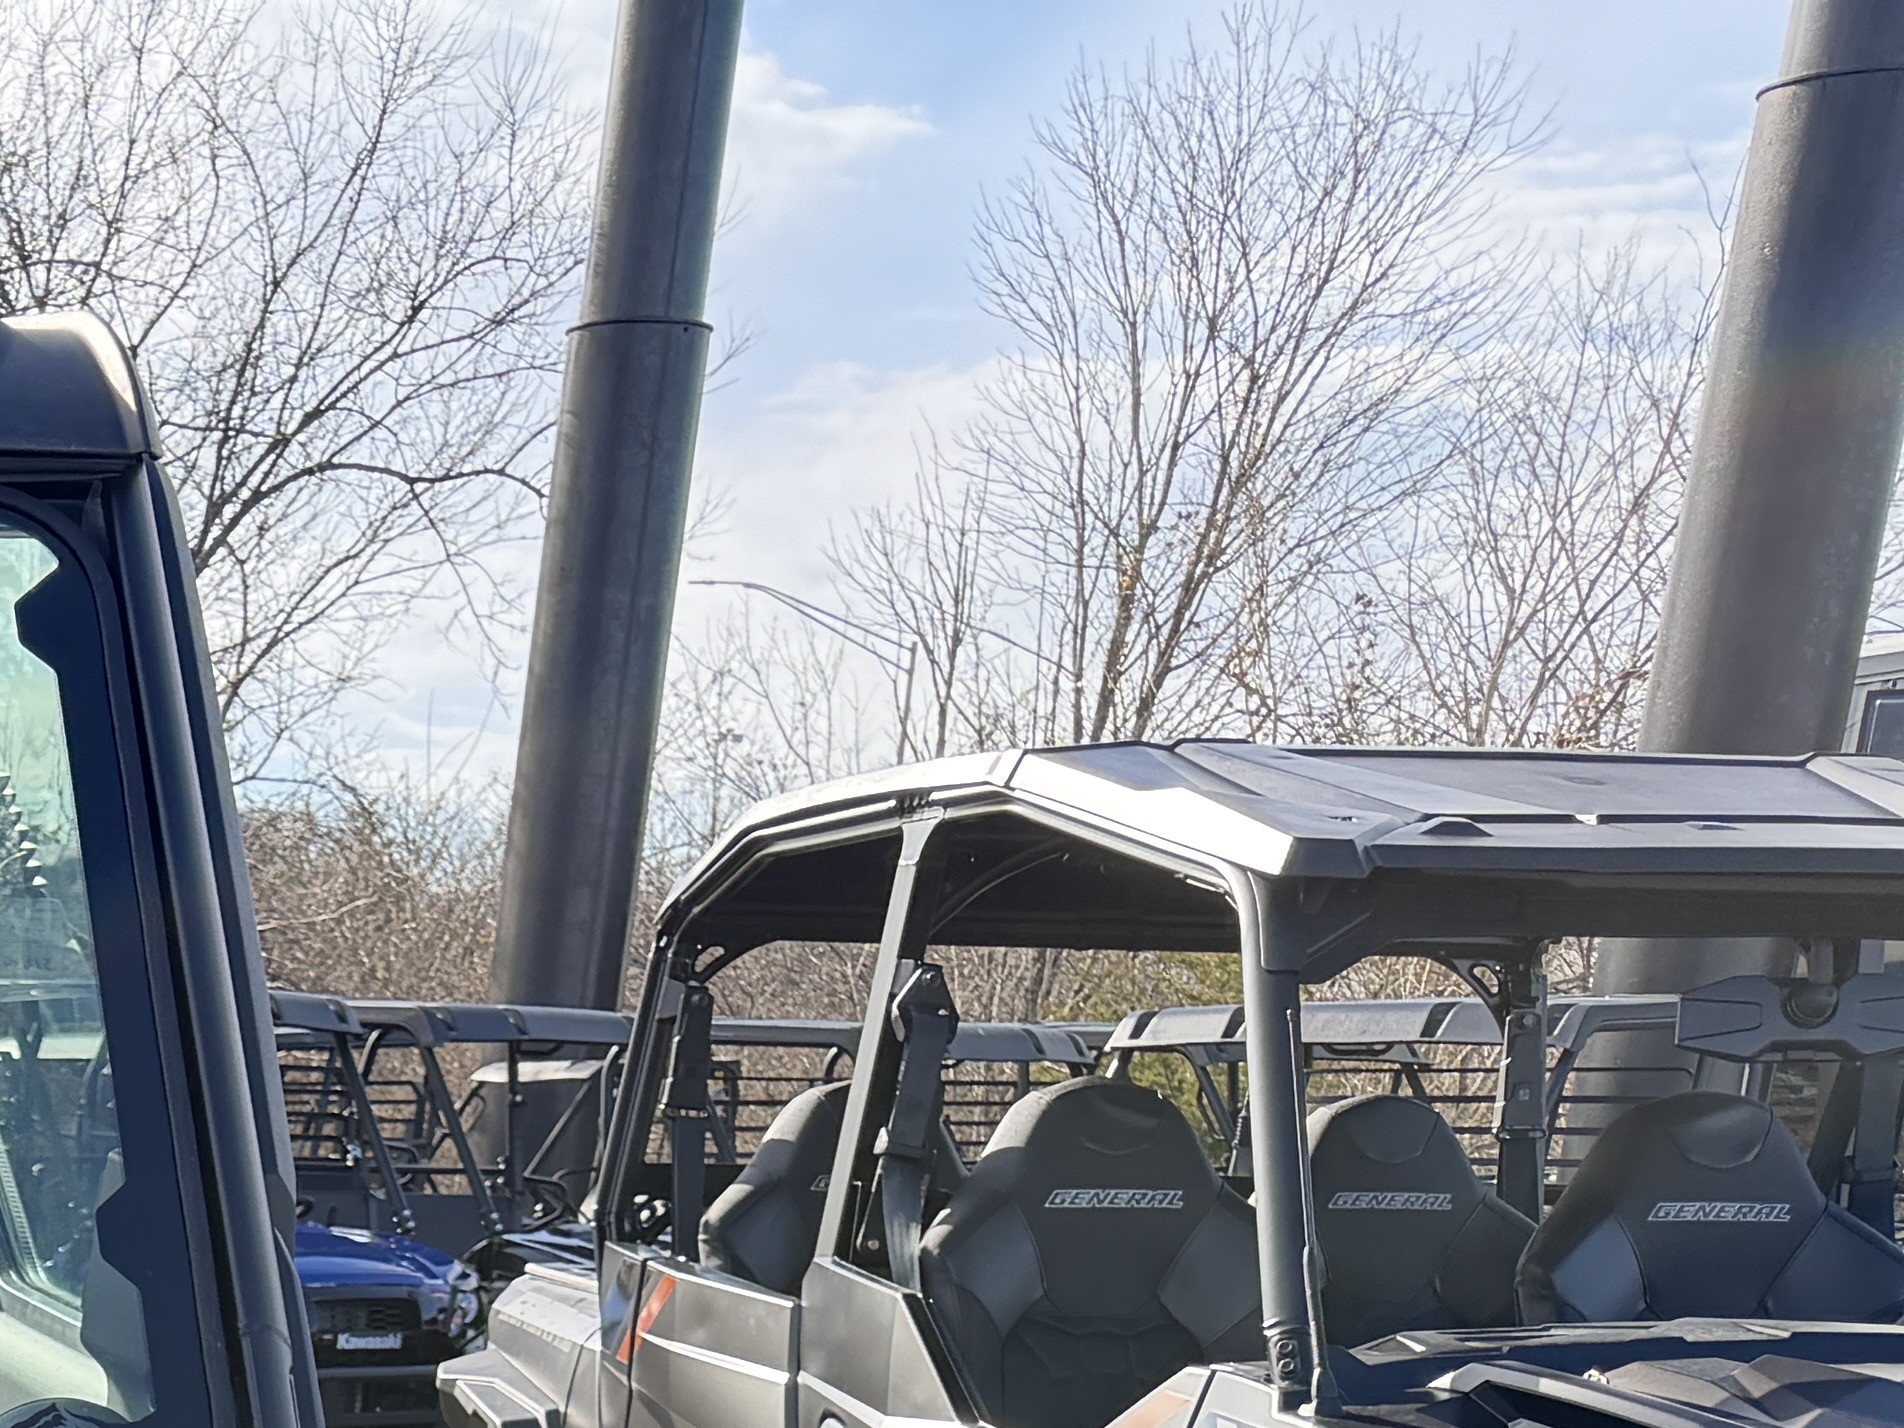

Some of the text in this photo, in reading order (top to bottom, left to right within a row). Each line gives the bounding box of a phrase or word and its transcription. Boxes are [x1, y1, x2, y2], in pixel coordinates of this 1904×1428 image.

[1044, 1189, 1184, 1208] GENERAL
[1328, 1192, 1453, 1211] GENERAL
[1647, 1202, 1792, 1222] GENERAL
